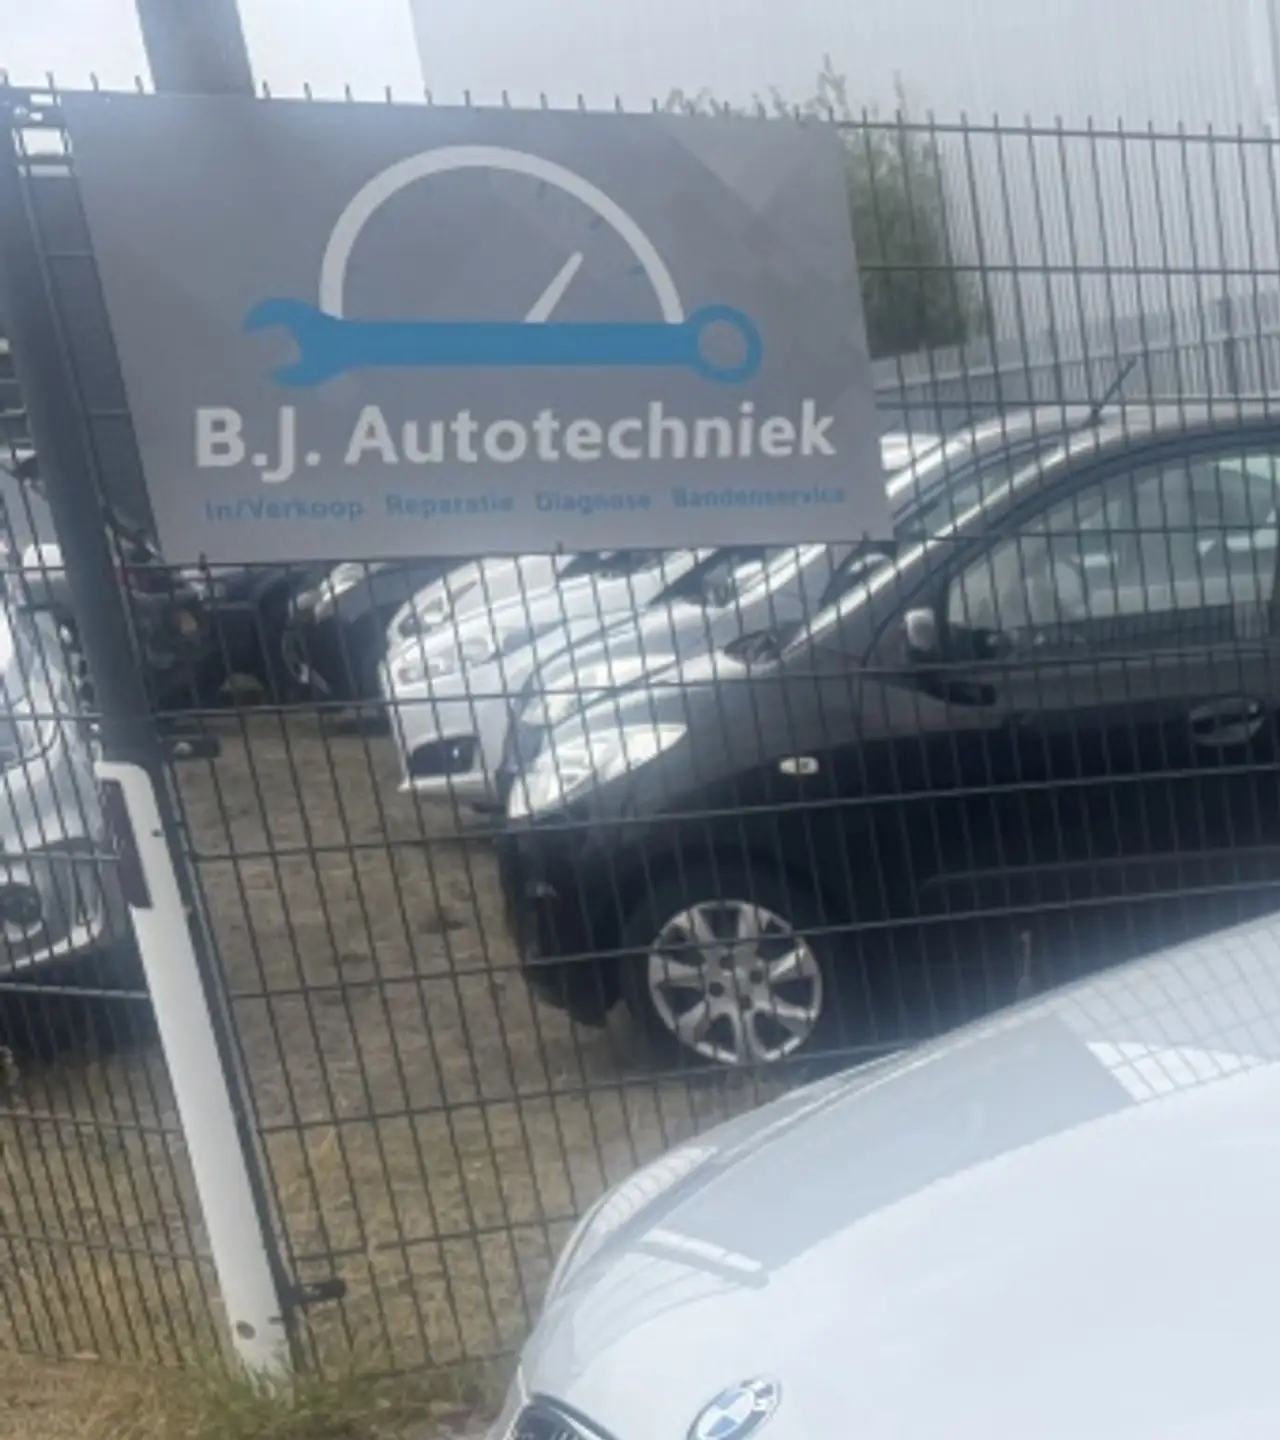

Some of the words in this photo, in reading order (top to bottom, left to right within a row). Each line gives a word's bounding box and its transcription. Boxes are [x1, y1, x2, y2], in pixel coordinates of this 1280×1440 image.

[195, 404, 321, 484] B.J.
[343, 397, 837, 466] Autotechniek
[204, 497, 364, 522] In/Verkoop
[385, 491, 515, 519] Reparatie
[535, 487, 651, 515] Diagnose
[671, 483, 847, 509] Bandenservice
